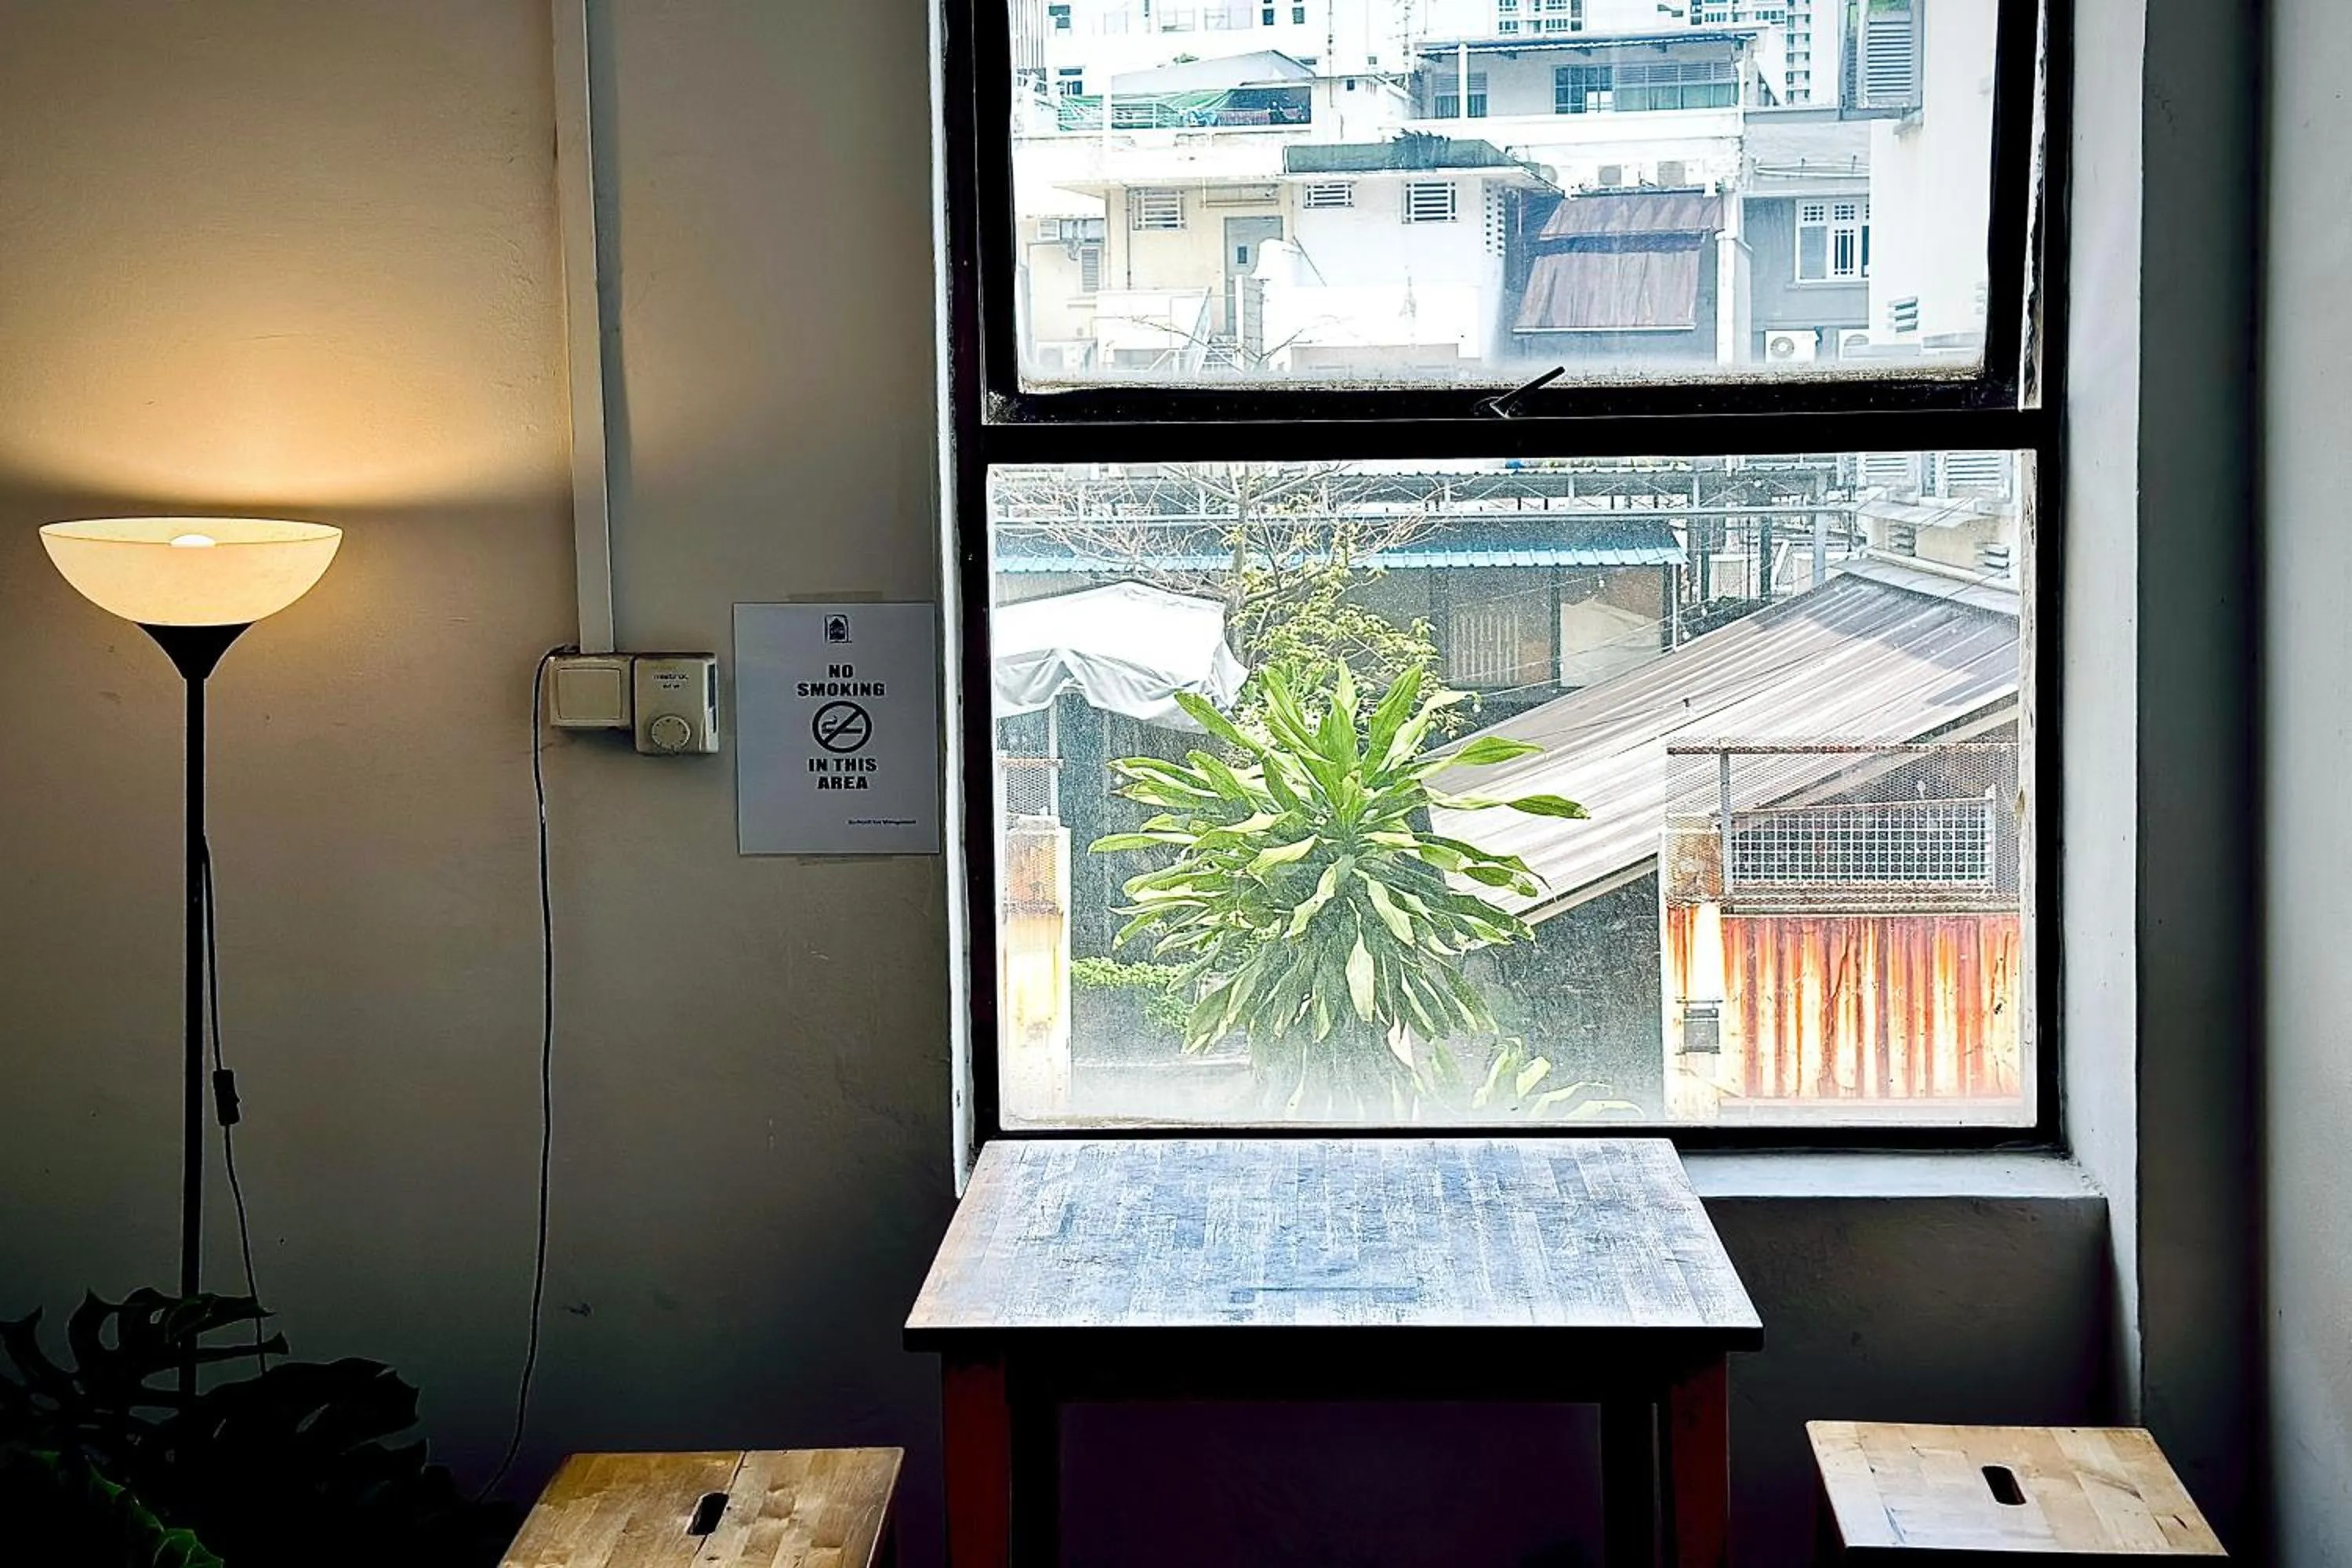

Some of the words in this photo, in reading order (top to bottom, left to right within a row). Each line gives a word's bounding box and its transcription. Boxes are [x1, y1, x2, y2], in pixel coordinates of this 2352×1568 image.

[829, 665, 854, 678] NO
[797, 683, 886, 697] SMOKING
[809, 758, 828, 772] IN
[833, 758, 877, 772] THIS
[817, 776, 869, 790] AREA
